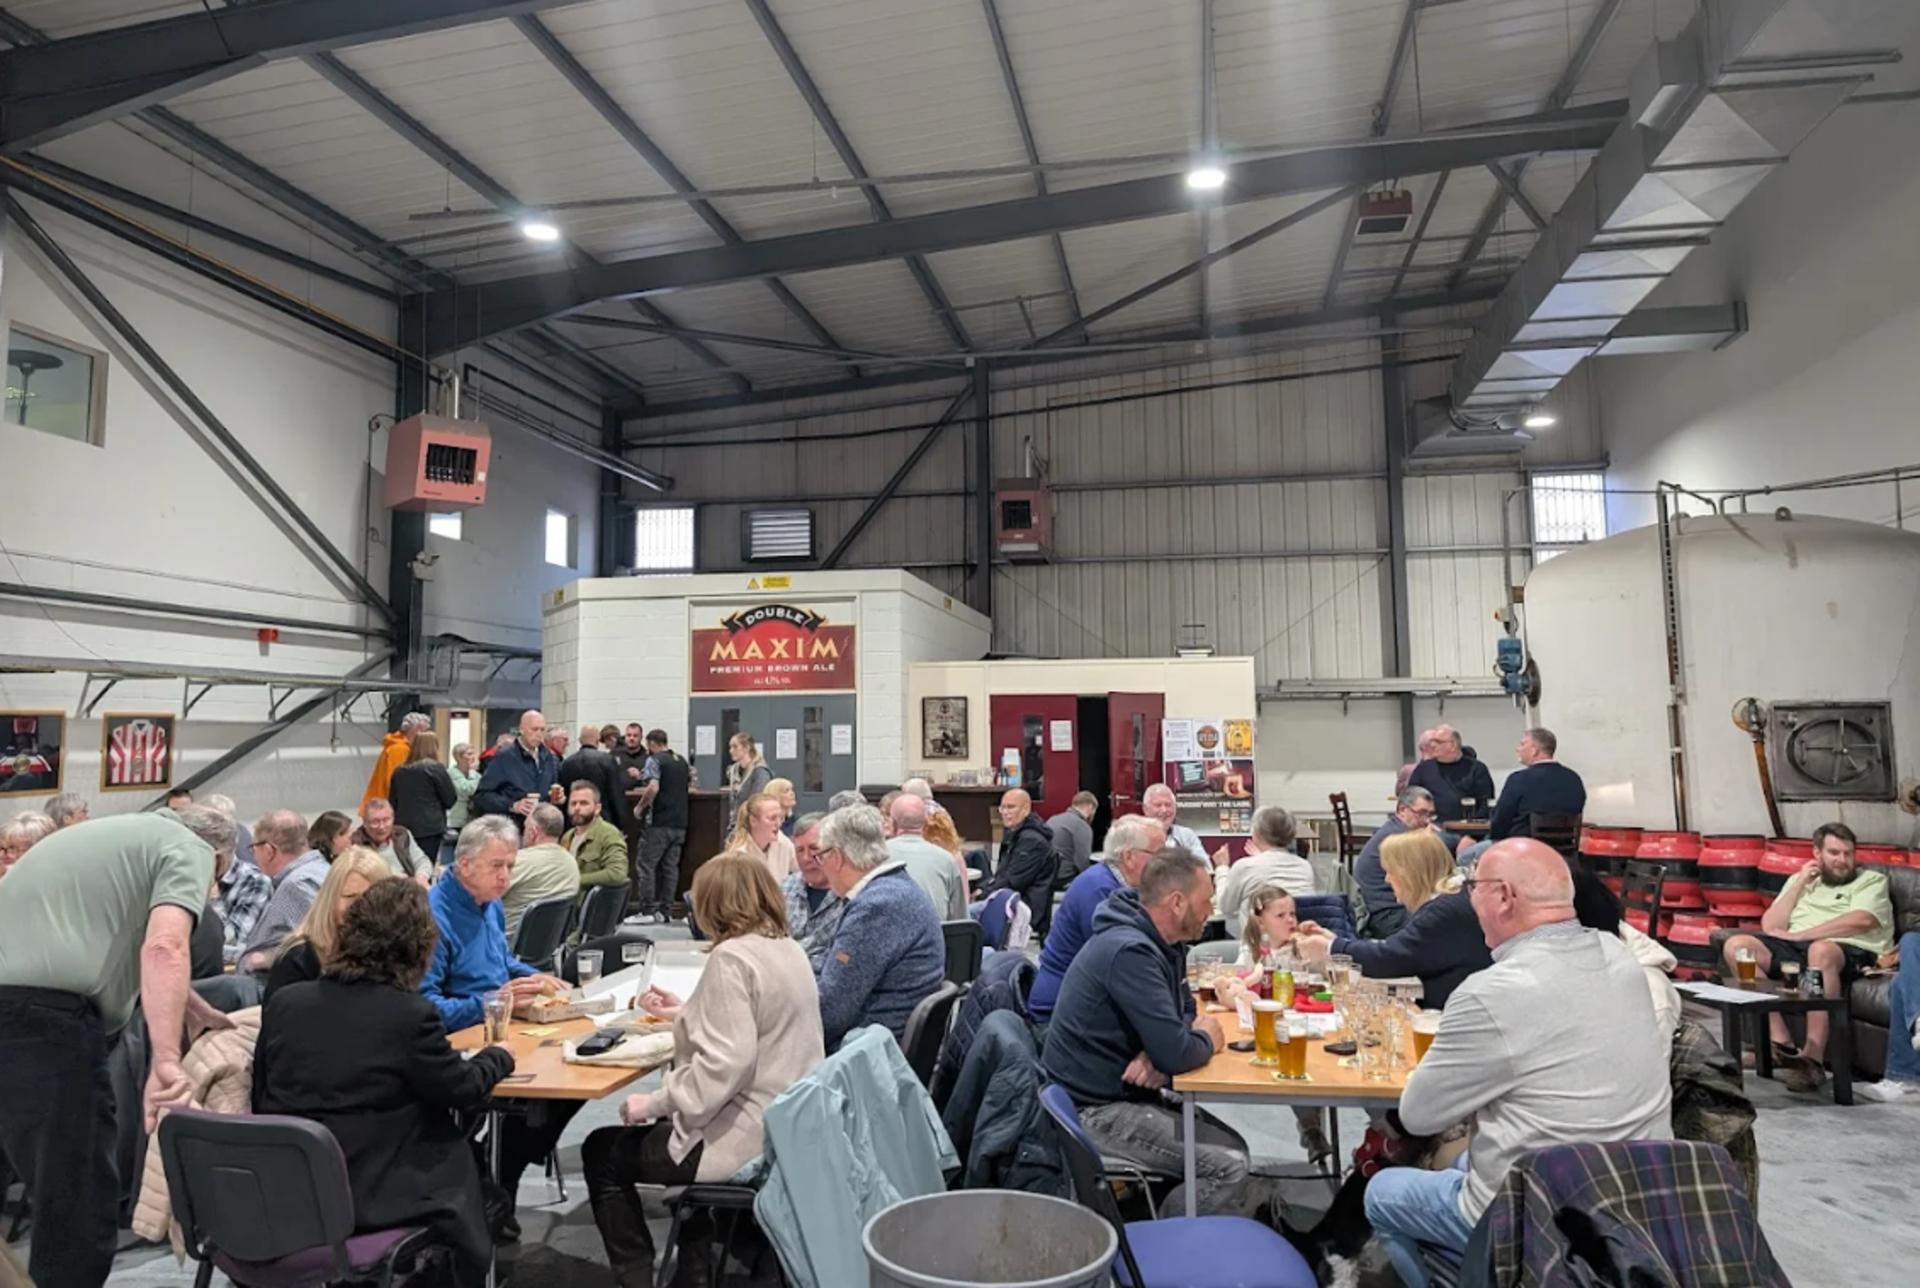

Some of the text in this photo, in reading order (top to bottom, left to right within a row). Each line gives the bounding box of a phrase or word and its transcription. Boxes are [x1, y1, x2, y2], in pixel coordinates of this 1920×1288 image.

[745, 607, 805, 625] DOUBLE
[709, 637, 840, 661] MAXIM
[710, 663, 835, 674] PREMIUM BROWN ALE
